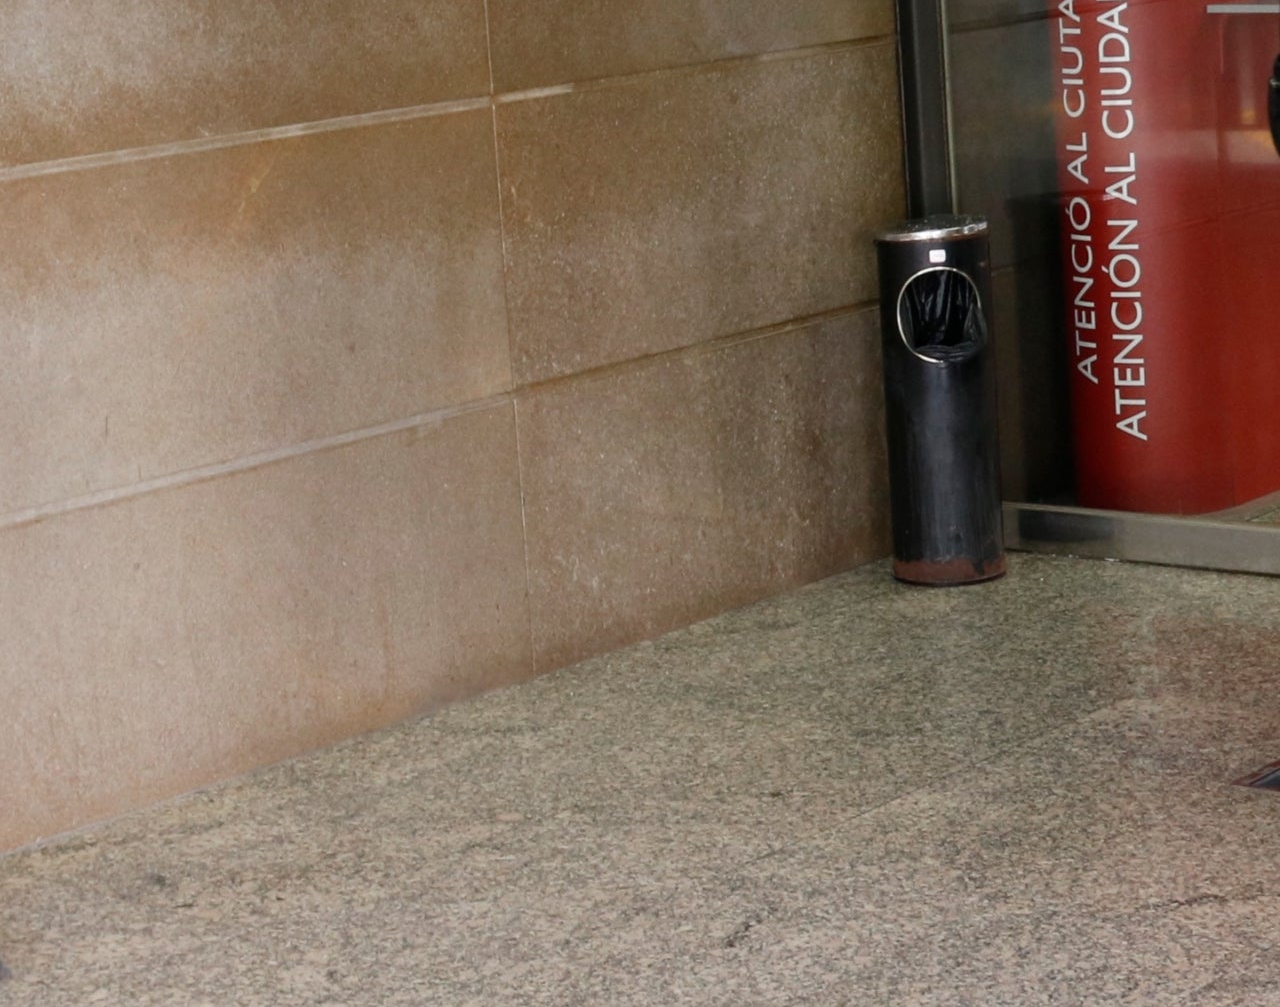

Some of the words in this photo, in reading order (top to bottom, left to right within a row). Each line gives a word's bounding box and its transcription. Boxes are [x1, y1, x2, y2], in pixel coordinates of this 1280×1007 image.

[1066, 132, 1089, 184] AL
[1104, 152, 1137, 205] AL
[1065, 196, 1099, 384] ATENCIÓ
[1101, 219, 1148, 441] ATENCIÓN
